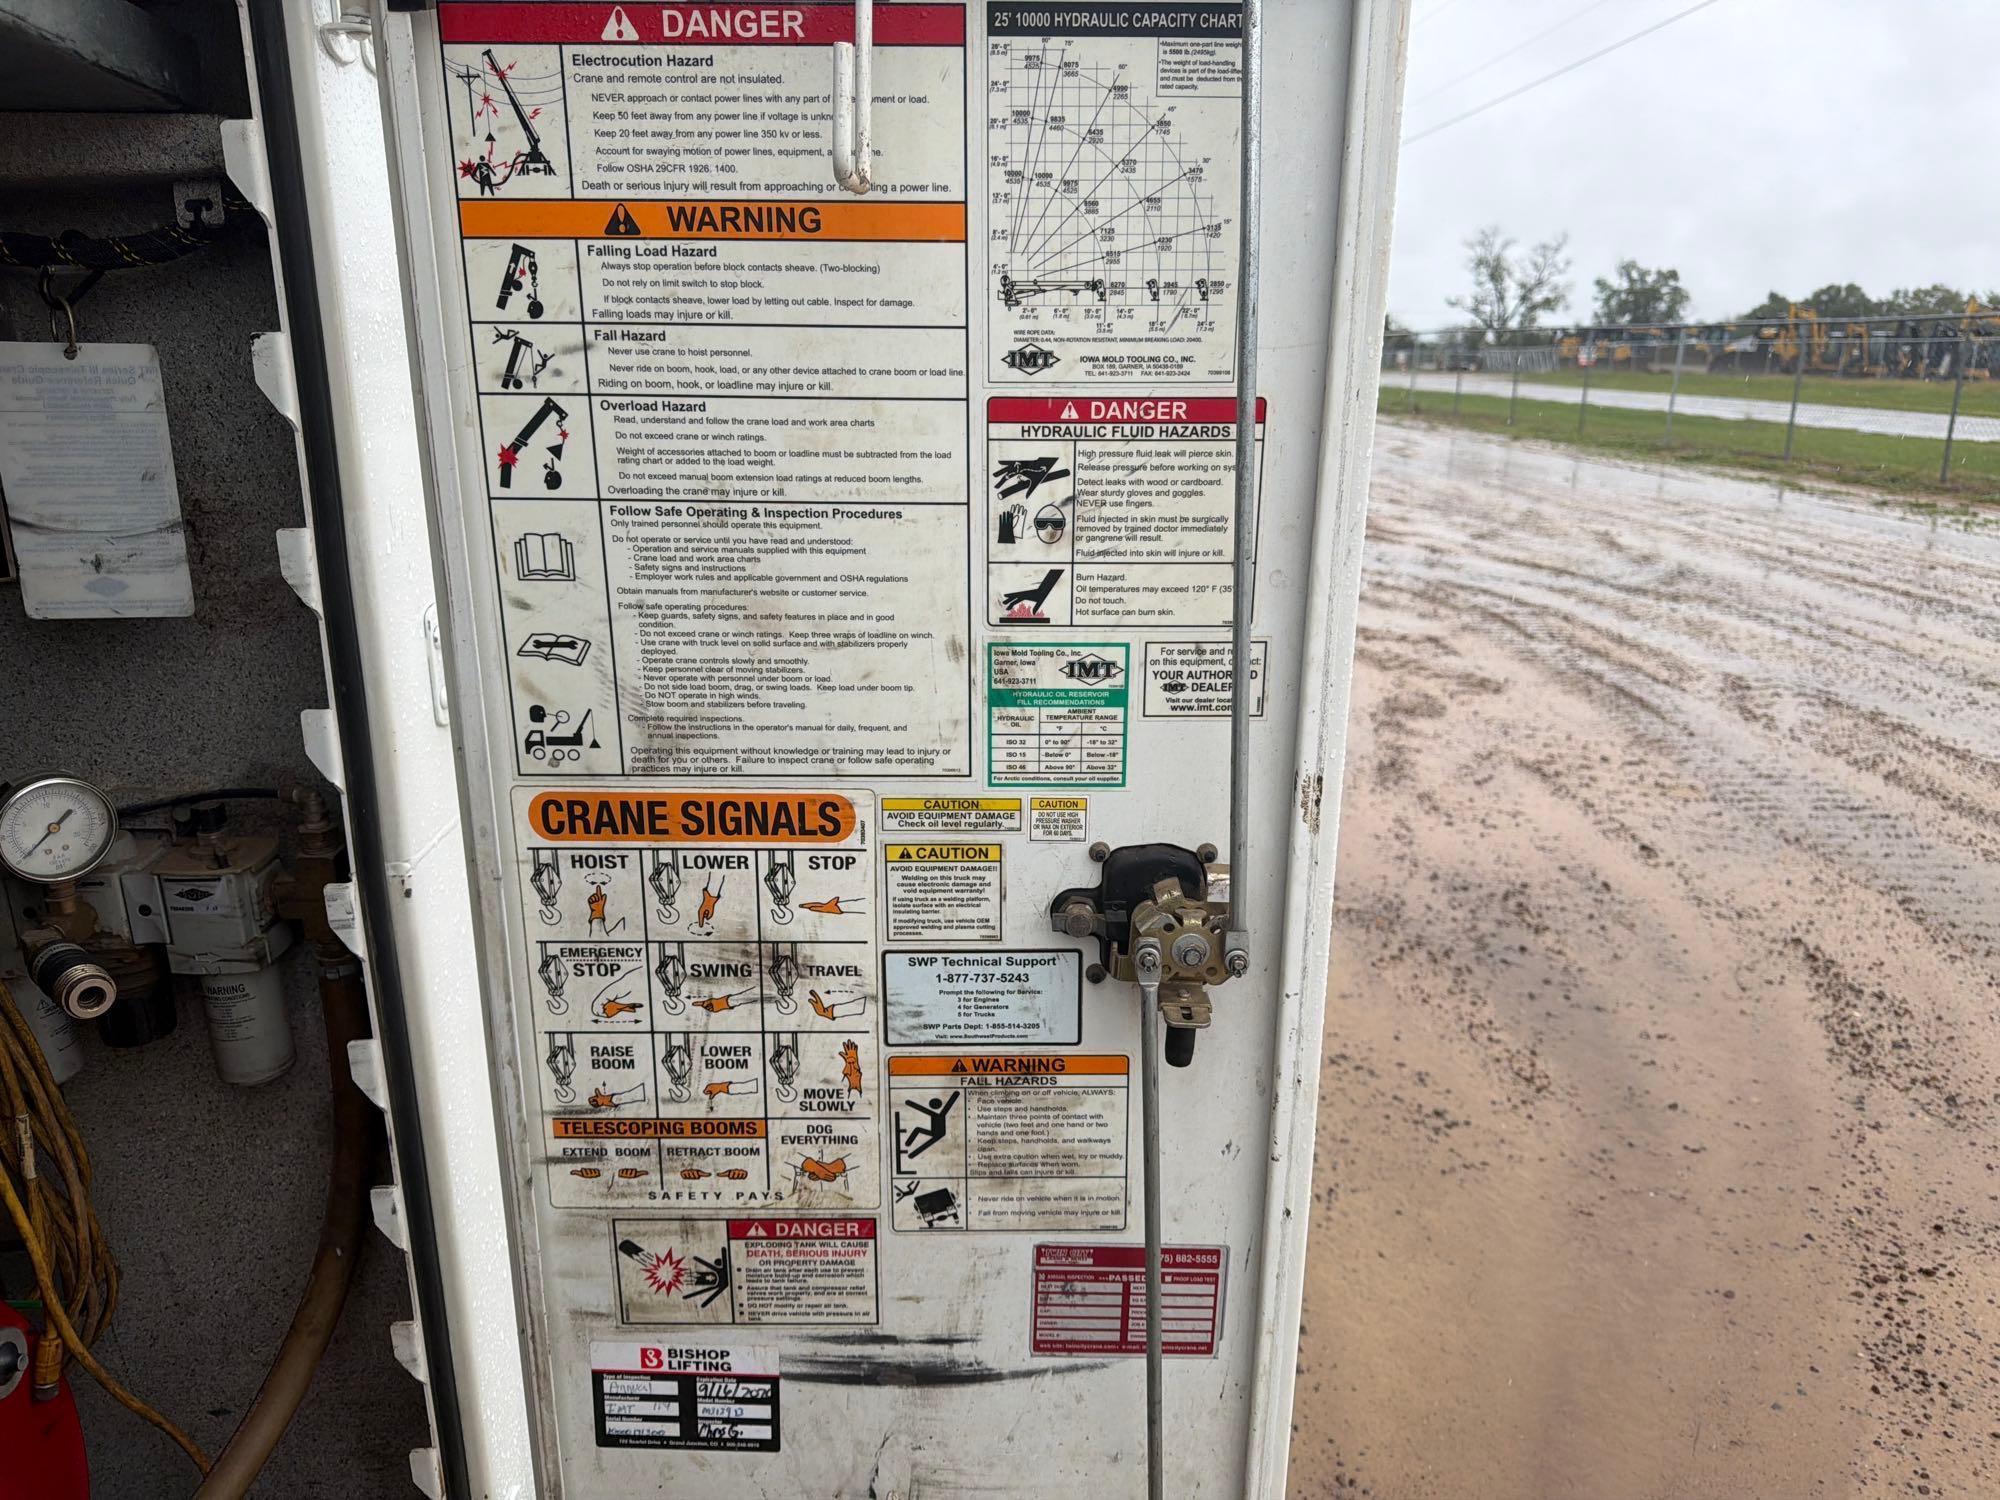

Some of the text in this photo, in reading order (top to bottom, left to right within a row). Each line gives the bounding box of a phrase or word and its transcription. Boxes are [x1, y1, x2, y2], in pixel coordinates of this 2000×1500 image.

[662, 9, 804, 38] DANGER
[994, 12, 1242, 27] 25' 10000 HYDRAULIC CAPACITY CHART
[572, 53, 713, 66] Electrocution Hazard
[574, 73, 784, 84] Crane and remote control are not insulated.
[666, 204, 821, 237] WARNING
[587, 243, 716, 259] Falling Load Hazard
[594, 329, 665, 341] Fall Hazard
[1008, 350, 1054, 367] IMT
[1080, 355, 1195, 364] IOWA MOLD TOOLING CO., INC.
[600, 399, 706, 412] Overload Hazard
[1091, 401, 1186, 419] DANGER
[1021, 426, 1230, 438] HYDRAULIC FLUID HAZARDS
[1078, 450, 1096, 460] High
[1098, 451, 1133, 460] pressure
[1136, 449, 1152, 457] fluid
[1188, 450, 1213, 458] pierce
[1215, 449, 1232, 457] skin.
[1077, 500, 1106, 508] NEVER
[1125, 499, 1153, 509] fingers.
[609, 505, 902, 521] Follow Safe Operating & Inspection Procedures
[1096, 573, 1126, 582] Hazard.
[1075, 596, 1086, 604] Do
[1102, 596, 1126, 604] touch.
[1029, 650, 1054, 658] Tooling
[1160, 647, 1225, 656] For service and
[994, 659, 1018, 667] Garner,
[1180, 658, 1225, 666] equipment,
[1067, 662, 1116, 678] IMT
[1153, 671, 1258, 680] YOUR AUTHORD
[924, 800, 979, 809] CAUTION
[1039, 800, 1078, 808] CAUTION
[541, 799, 669, 835] CRANE
[681, 798, 841, 836] SIGNALS
[887, 812, 1015, 820] AVOID EQUIPMENT DAMAGE
[964, 820, 1006, 829] regularly.
[916, 848, 988, 859] CAUTION
[570, 854, 628, 868] HOIST
[682, 854, 748, 869] LOWER
[808, 856, 856, 870] STOP
[560, 948, 642, 958] EMERGENCY
[908, 956, 1056, 968] SWP Technical Support
[573, 963, 621, 977] STOP
[690, 964, 751, 977] SWING
[807, 966, 862, 977] TRAVEL
[936, 972, 1029, 985] 1-877-737-5243
[590, 1046, 633, 1057] RAISE
[700, 1044, 751, 1056] LOWER
[591, 1058, 634, 1069] BOOM
[705, 1058, 748, 1069] BOOM
[972, 1058, 1065, 1072] WARNING
[961, 1077, 1057, 1085] FALL HAZARDS
[804, 1088, 843, 1101] MOVE
[799, 1102, 855, 1112] SLOWLY
[560, 1121, 757, 1134] TELESCOPING BOOMS
[806, 1125, 833, 1134] DOG
[781, 1134, 858, 1145] EVERYTHING
[563, 1147, 650, 1157] EXTEND BOOM
[667, 1147, 760, 1157] RETRACT BOOM
[648, 1191, 784, 1201] SAFETY PAYS
[776, 1222, 858, 1236] DANGER
[745, 1241, 869, 1249] EXPLODING TANK WILL CAUSE
[747, 1250, 783, 1258] DEATH,
[832, 1250, 867, 1258] INJURY
[668, 1349, 729, 1361] BISHOP
[668, 1360, 731, 1372] LIFTING
